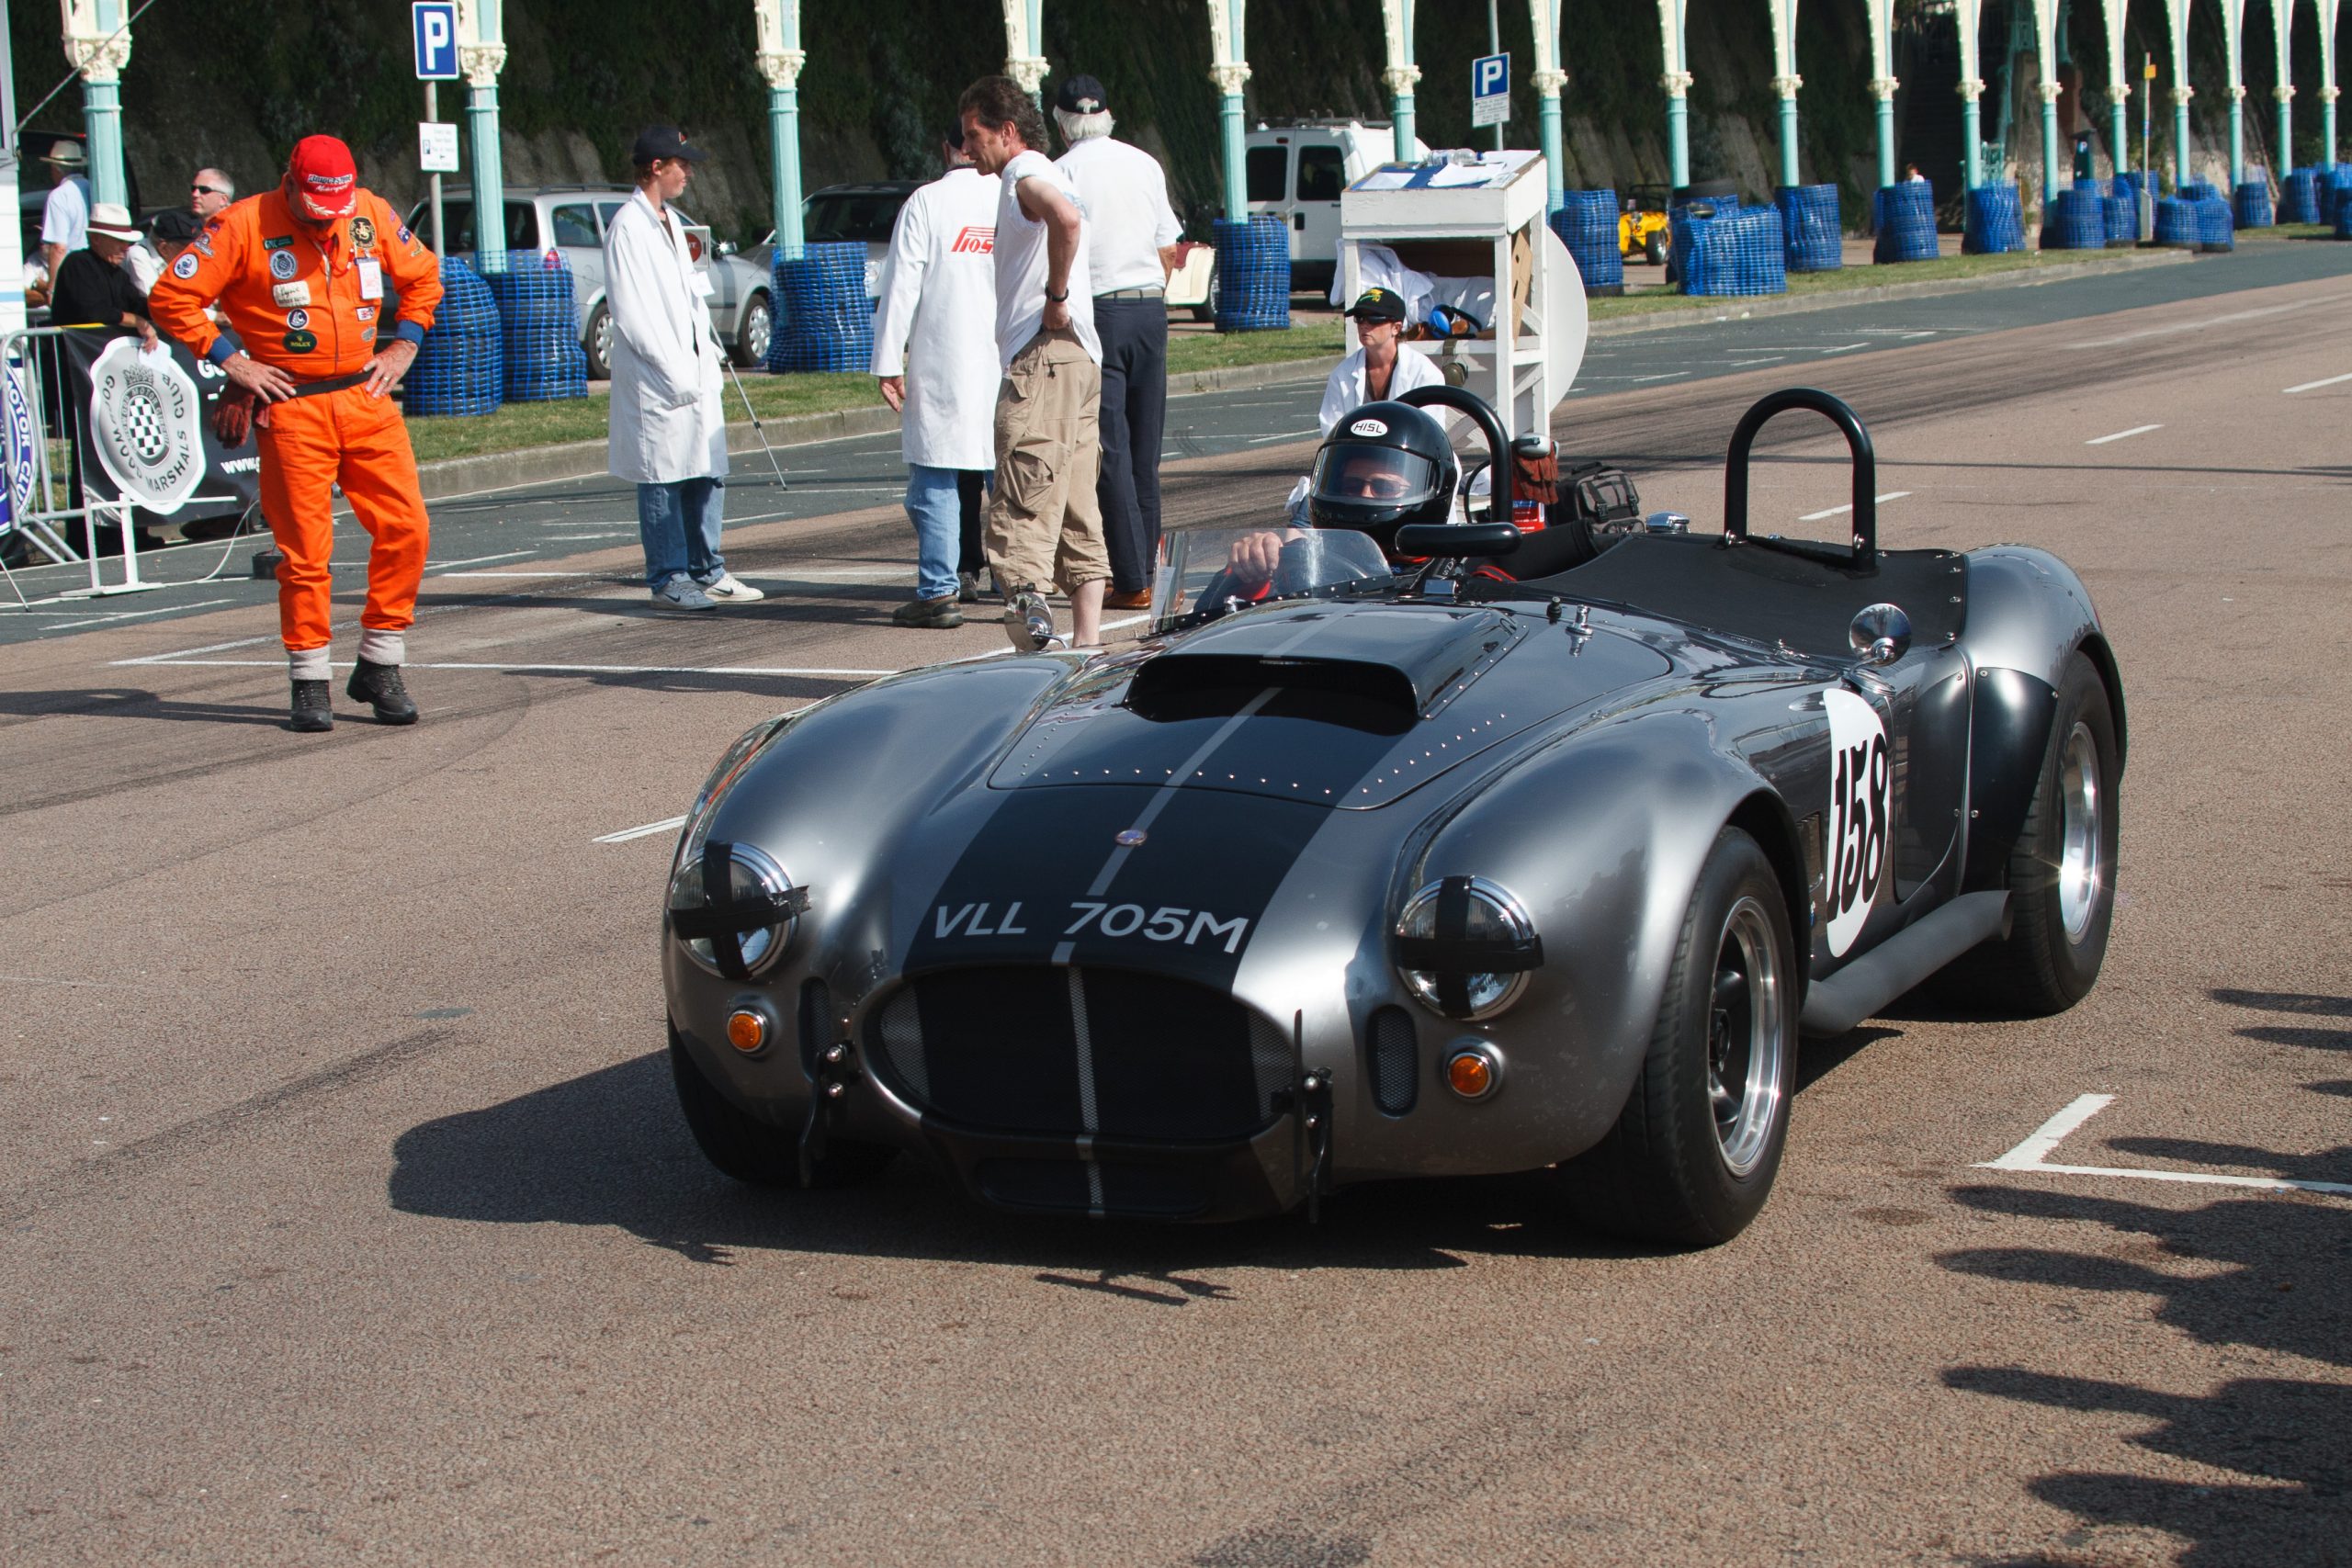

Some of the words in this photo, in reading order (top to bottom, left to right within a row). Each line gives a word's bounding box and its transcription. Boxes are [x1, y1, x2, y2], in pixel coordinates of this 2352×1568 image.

[424, 12, 448, 71] P
[1482, 60, 1502, 96] P
[162, 373, 184, 419] CLUB
[1353, 423, 1382, 434] HISL
[16, 460, 31, 506] CLU
[146, 431, 189, 492] MARSHALS
[1826, 733, 1888, 924] 158
[934, 901, 1027, 939] VLL
[1064, 902, 1250, 954] 705M
